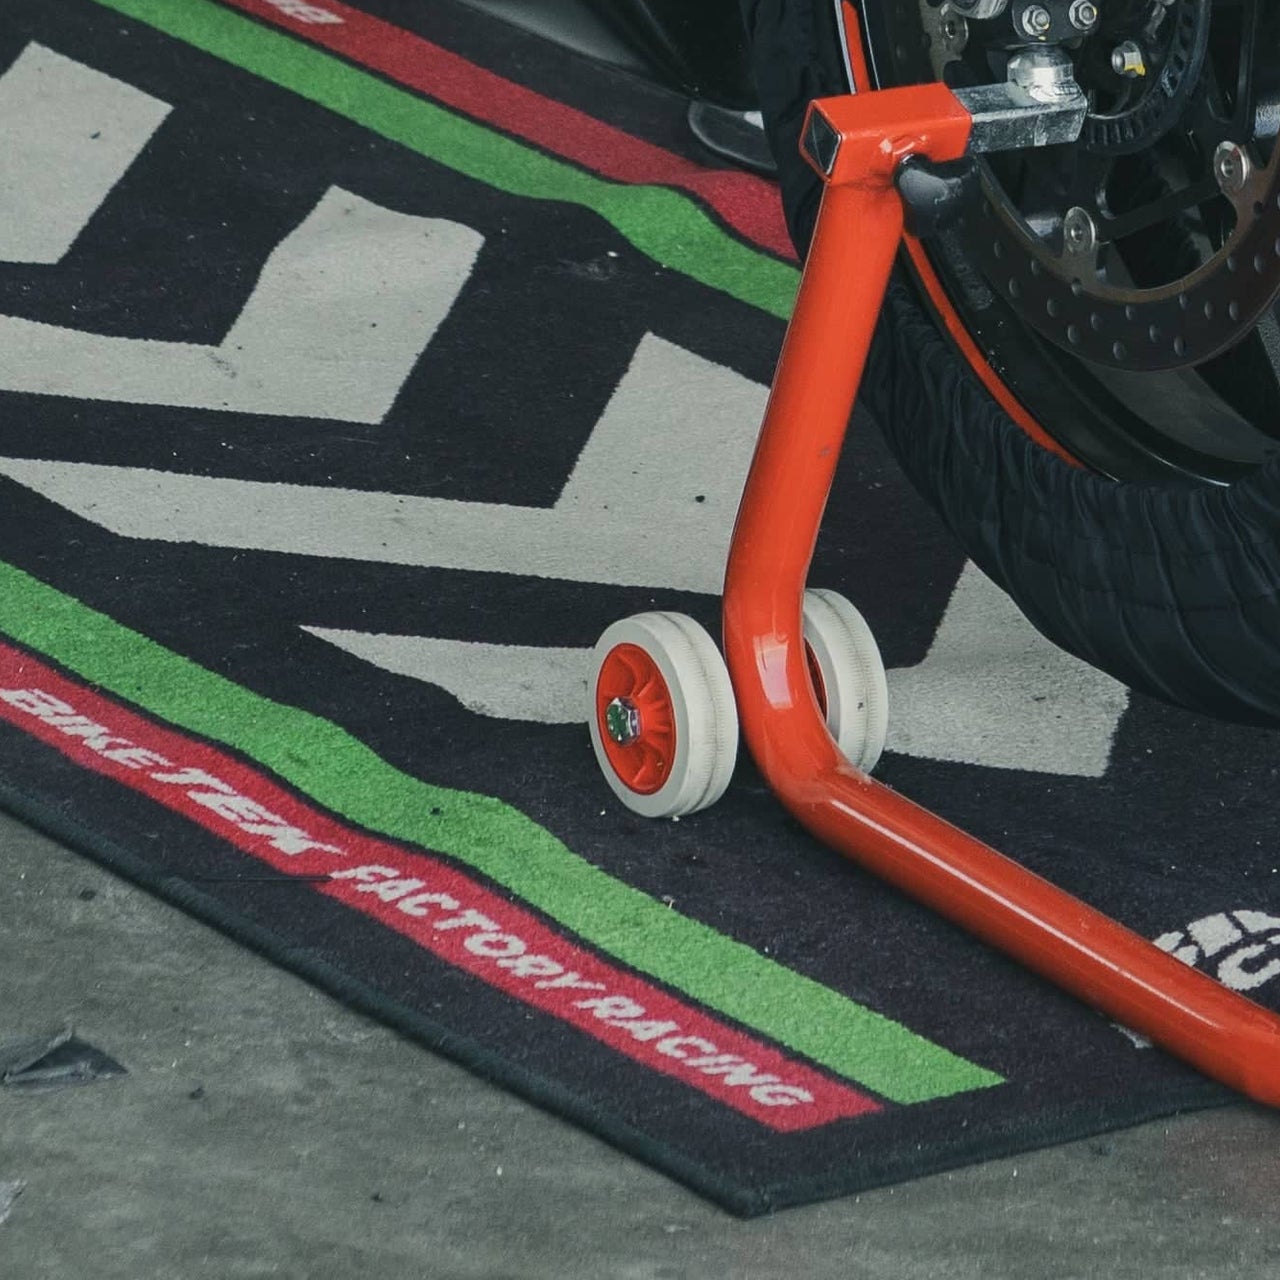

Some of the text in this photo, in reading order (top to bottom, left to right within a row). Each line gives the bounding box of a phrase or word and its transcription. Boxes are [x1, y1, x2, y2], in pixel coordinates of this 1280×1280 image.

[150, 760, 347, 858] TEK
[329, 864, 604, 996] FACTORY
[576, 991, 814, 1110] RACING
